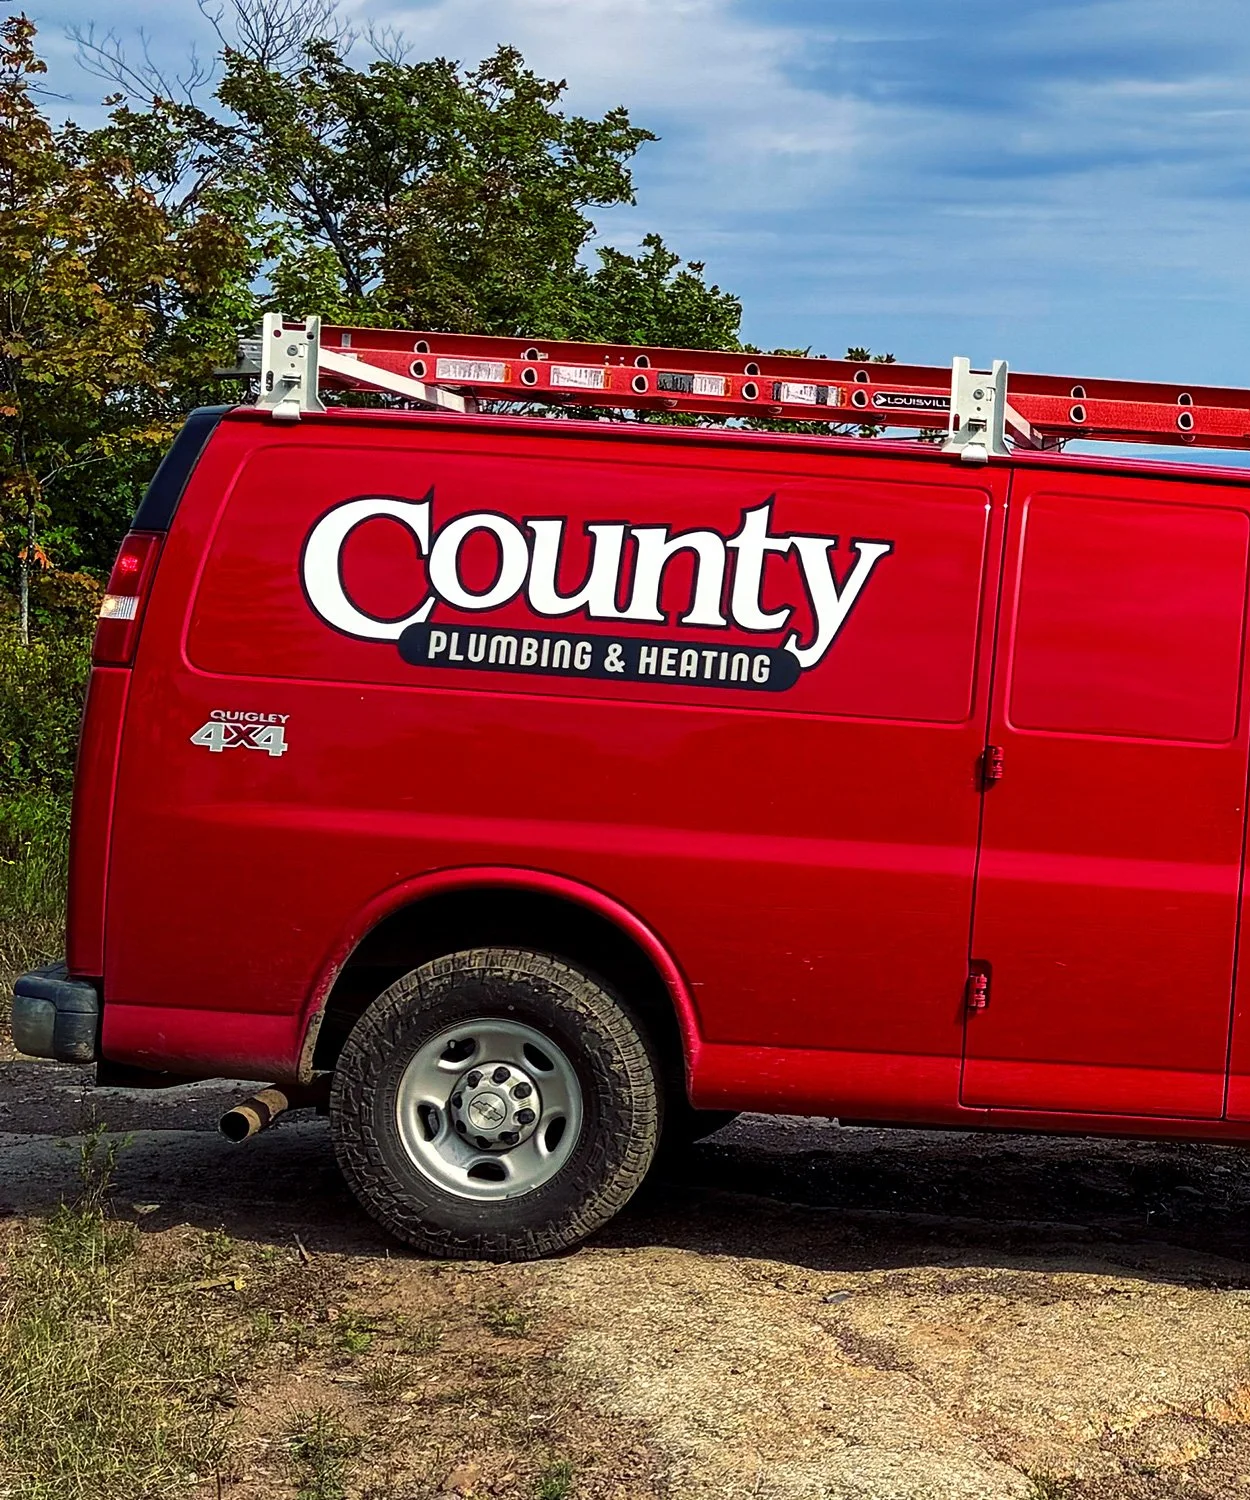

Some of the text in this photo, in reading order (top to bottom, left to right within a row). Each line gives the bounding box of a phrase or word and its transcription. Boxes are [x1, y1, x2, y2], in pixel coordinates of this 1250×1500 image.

[888, 397, 951, 407] LOUISVILL
[301, 488, 893, 670] County
[427, 630, 771, 684] PLUMBING & HEATING
[210, 709, 290, 724] QUIGLEY
